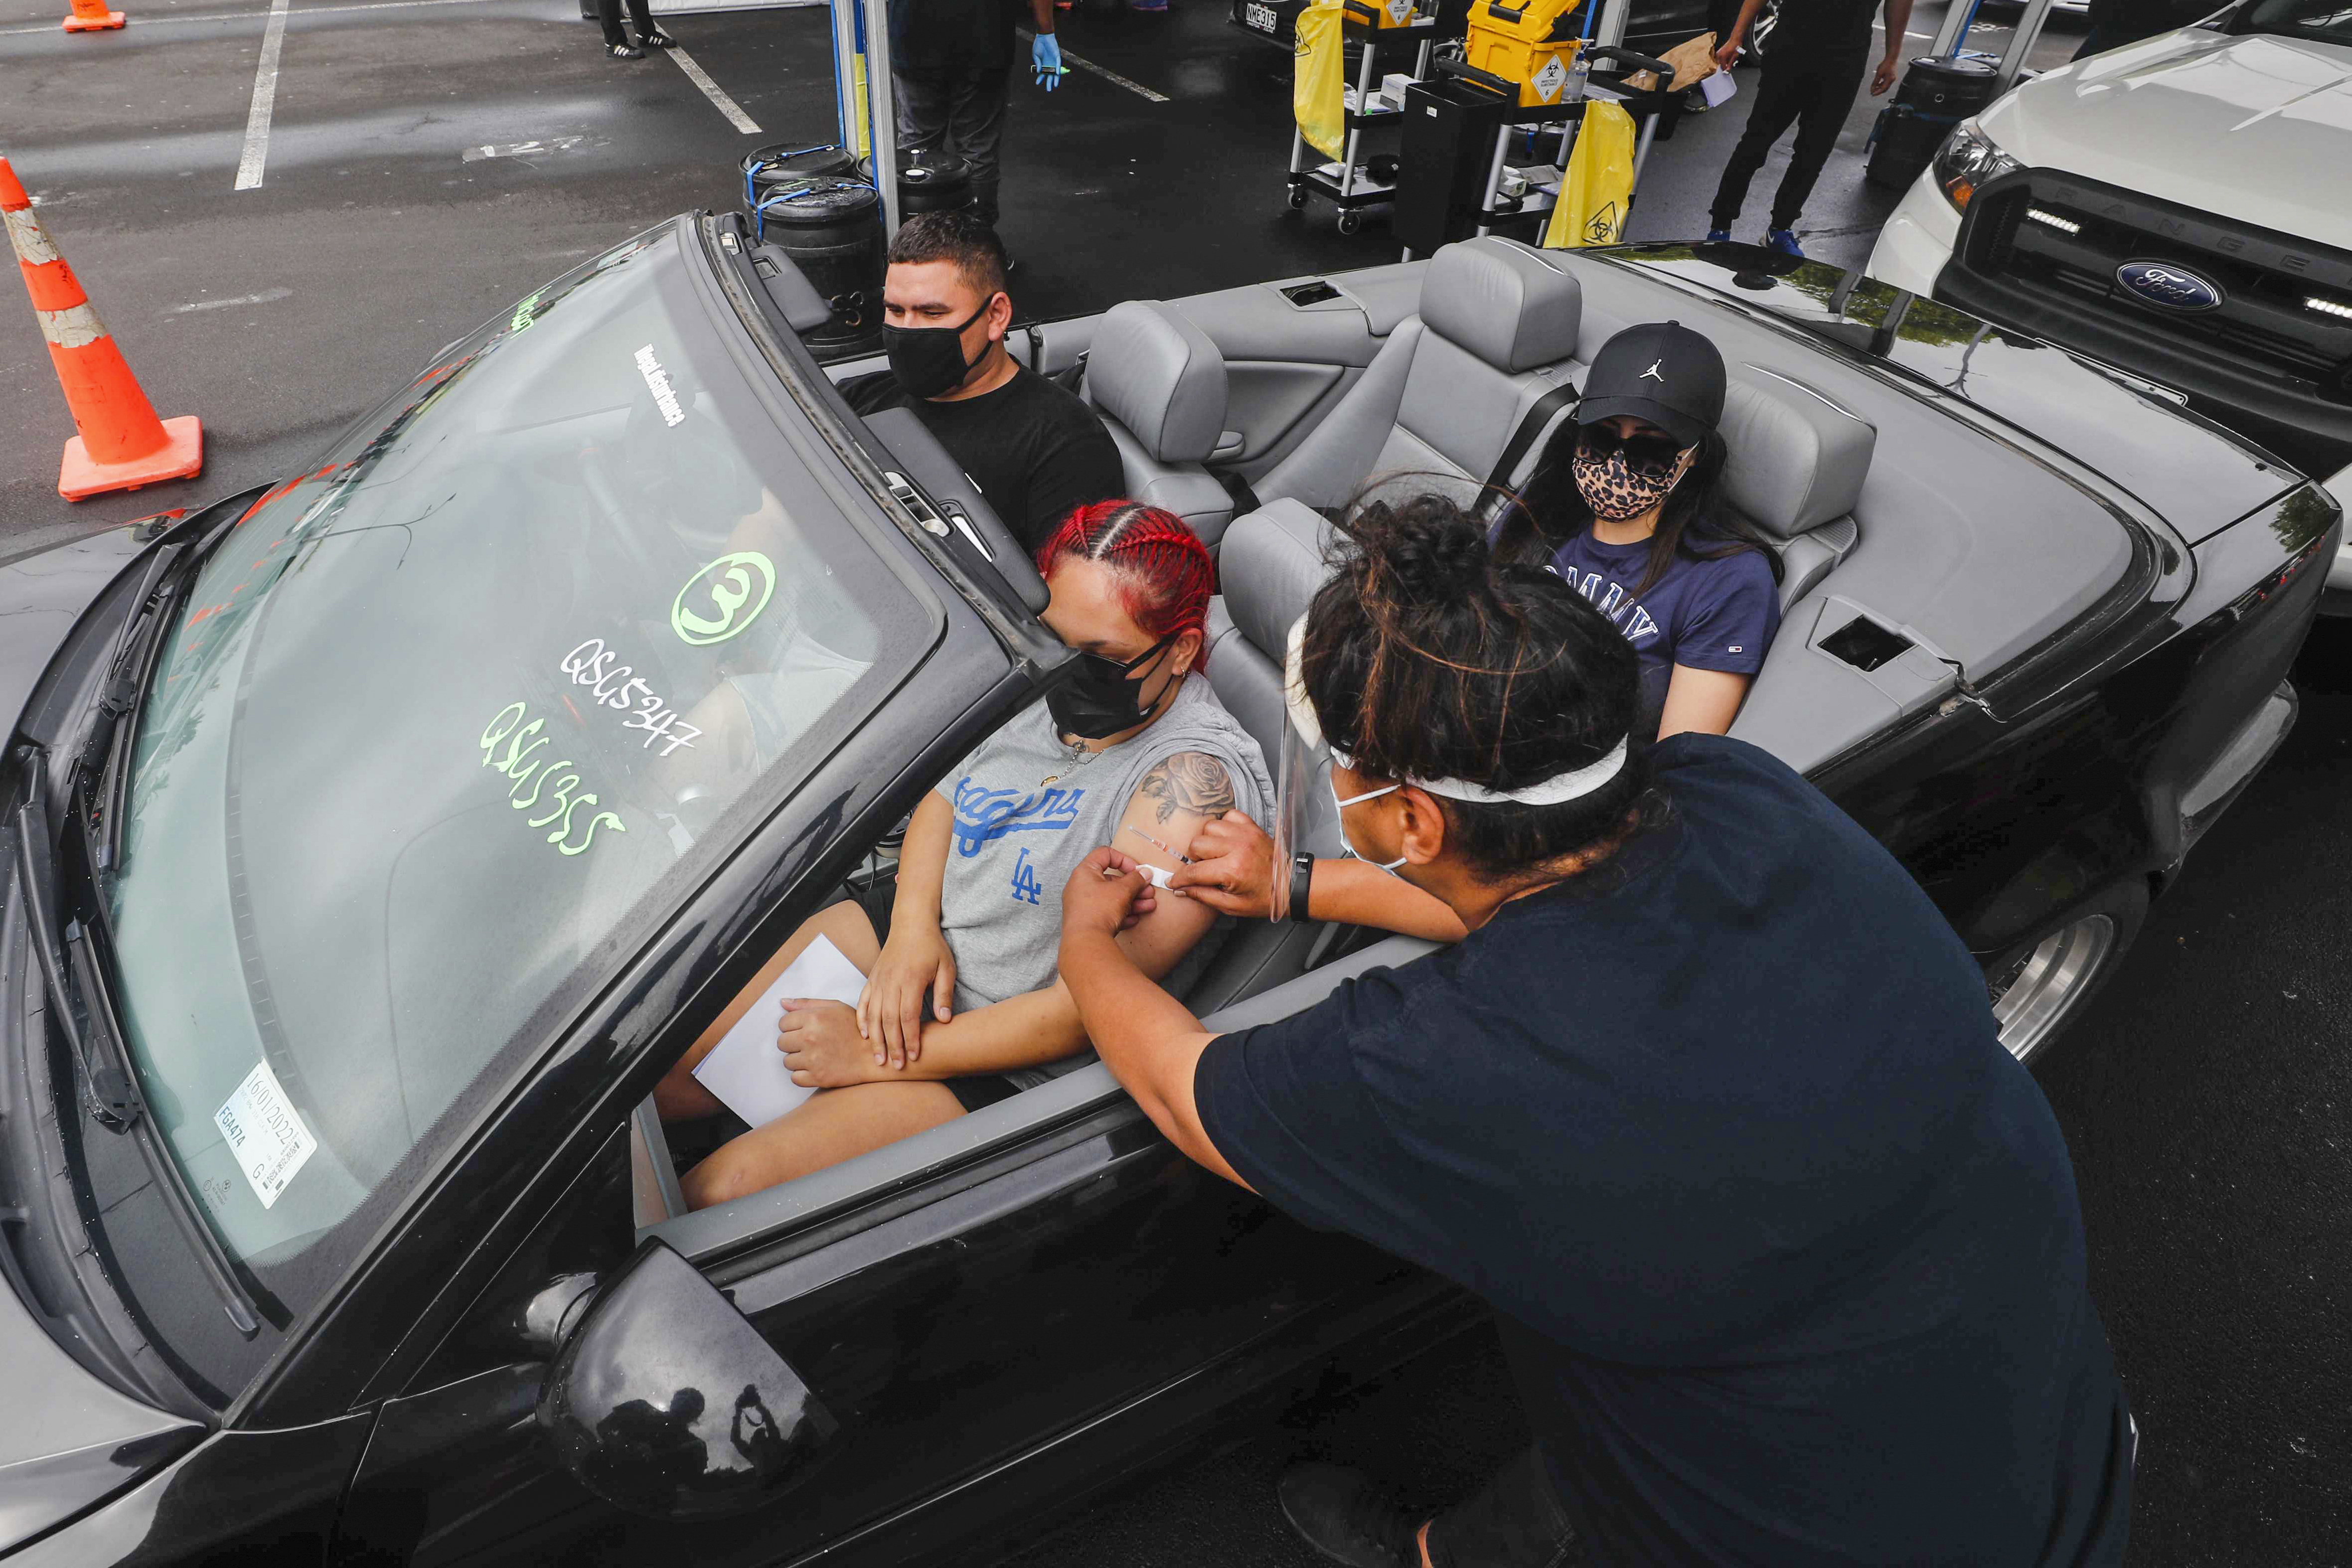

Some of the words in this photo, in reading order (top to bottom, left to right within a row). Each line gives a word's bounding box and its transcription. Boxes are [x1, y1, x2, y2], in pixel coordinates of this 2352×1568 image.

[1247, 5, 1275, 28] NME315
[2135, 268, 2197, 301] Ford
[680, 567, 751, 634] 3
[1011, 847, 1042, 906] LA
[219, 1106, 246, 1148] FGA474
[247, 1073, 294, 1145] 16/01/2022
[253, 1163, 265, 1180] G
